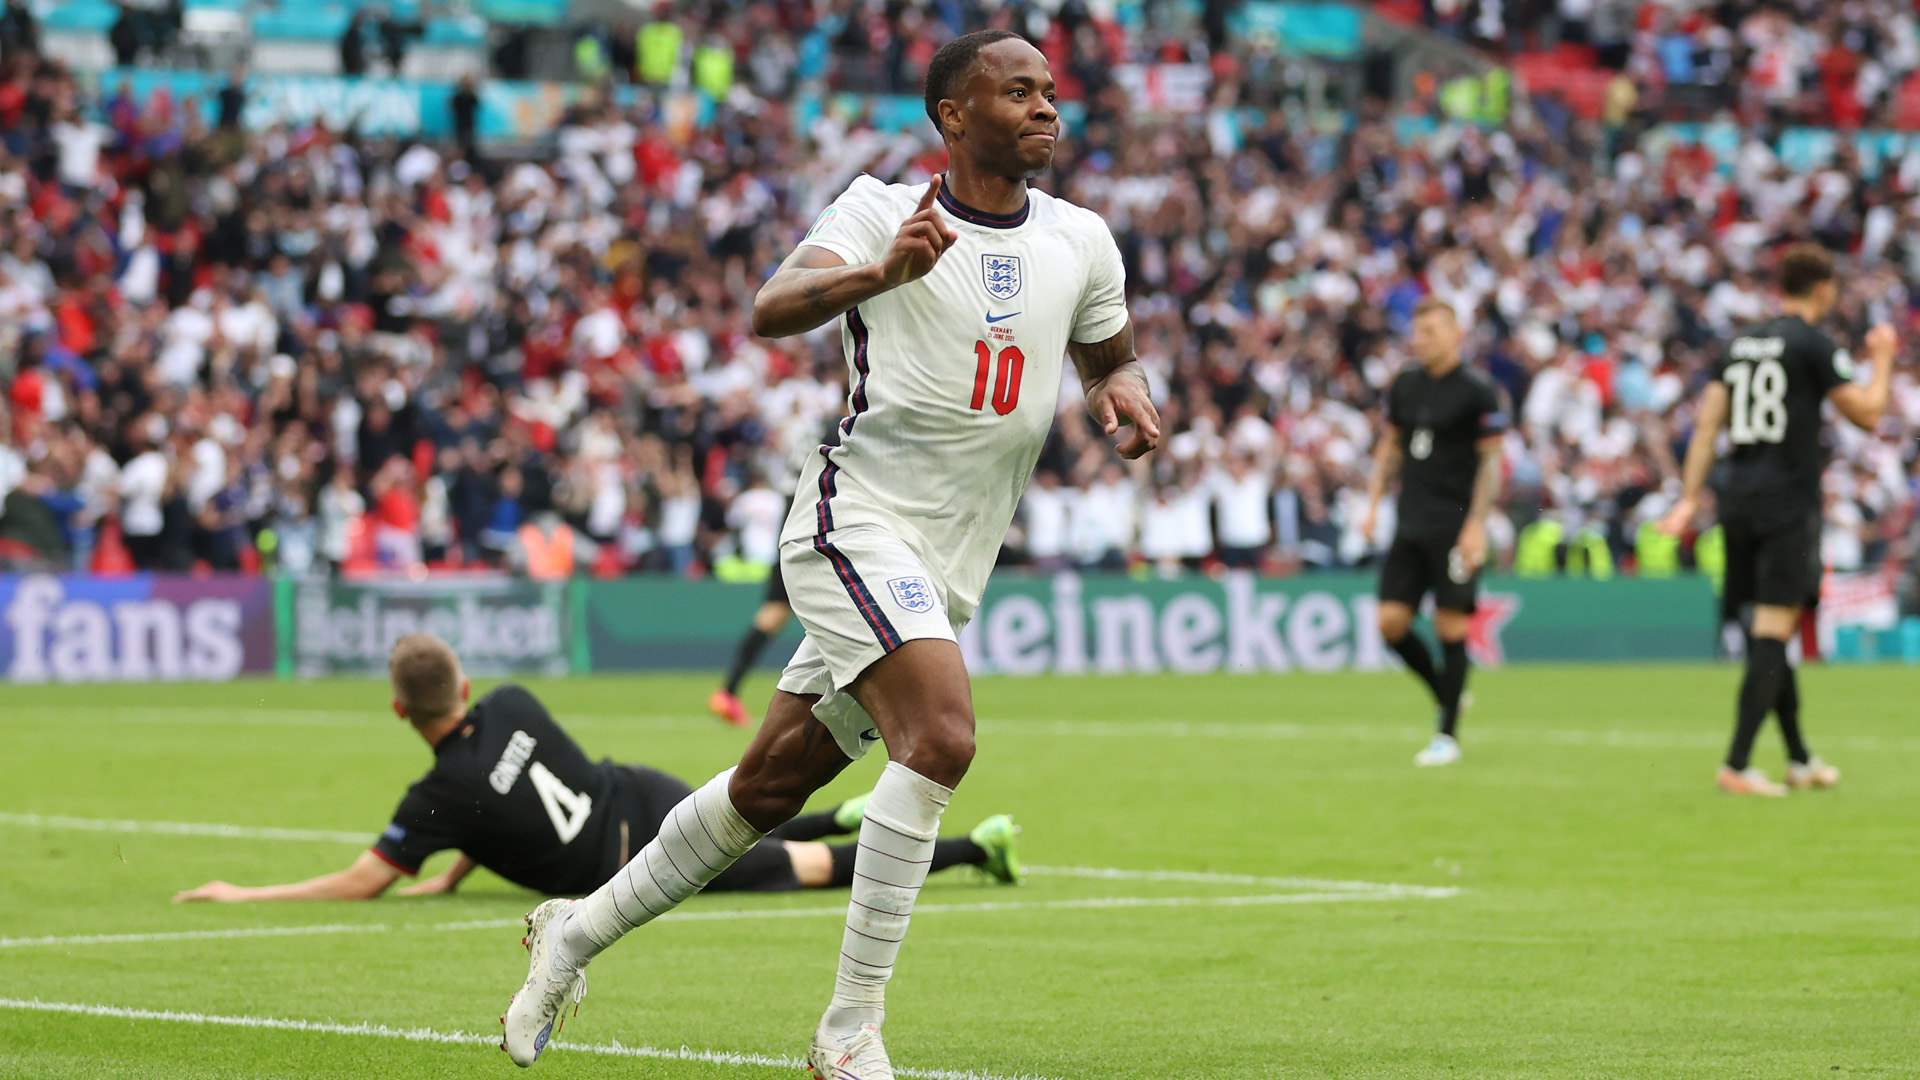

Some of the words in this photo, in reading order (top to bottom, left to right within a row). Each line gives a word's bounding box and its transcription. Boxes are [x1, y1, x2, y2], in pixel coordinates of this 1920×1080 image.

[990, 326, 1012, 335] GERMANY
[993, 333, 1004, 341] JUNE
[970, 340, 1025, 416] 10
[1722, 358, 1787, 445] 18
[7, 573, 244, 682] fans
[489, 729, 537, 795] GINTER
[528, 760, 593, 845] 4
